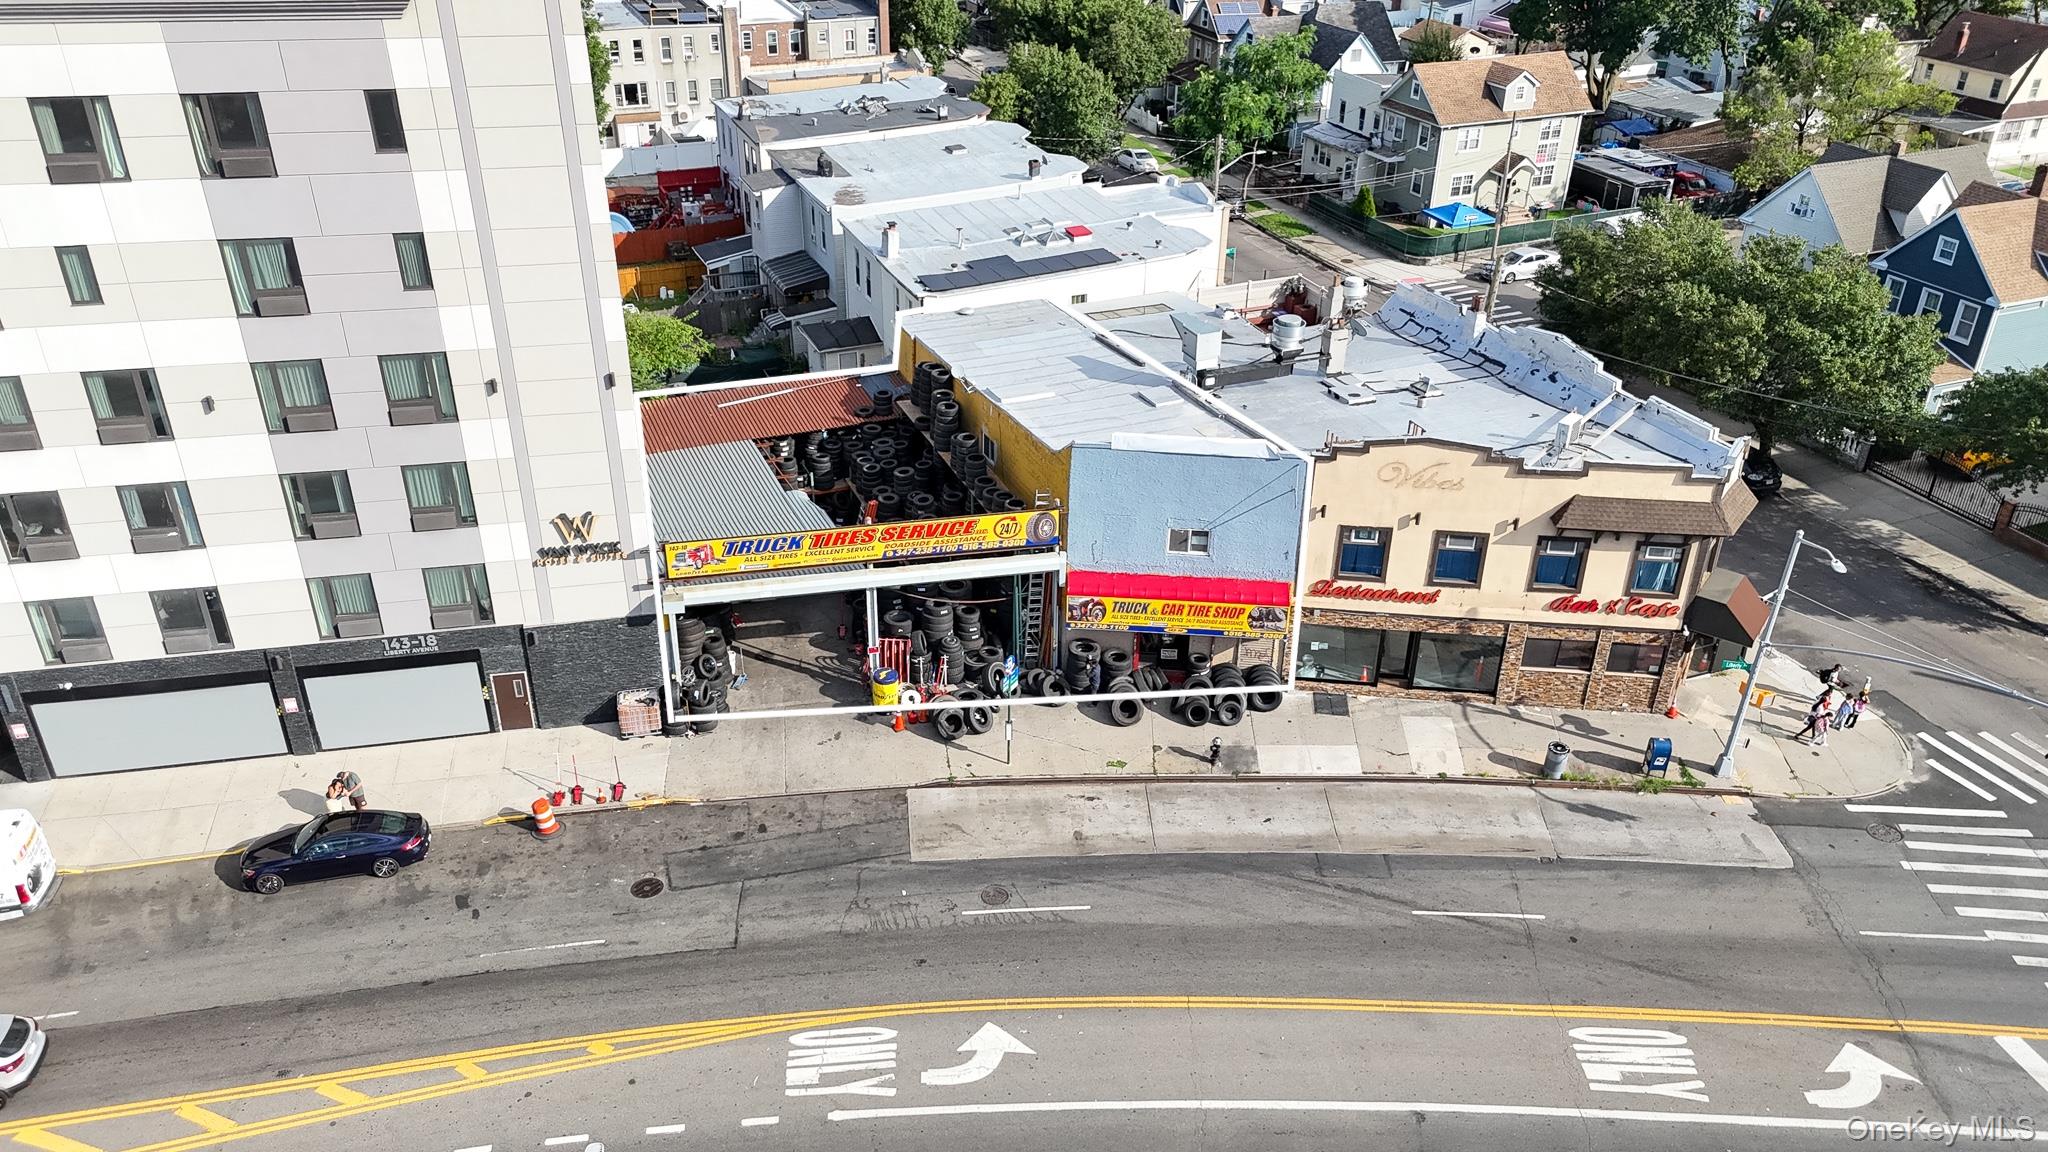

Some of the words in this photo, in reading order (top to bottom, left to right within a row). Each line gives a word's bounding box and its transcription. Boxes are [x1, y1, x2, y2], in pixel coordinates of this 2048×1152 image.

[1377, 462, 1464, 491] Vibes
[722, 533, 807, 557] TRUCK
[809, 527, 879, 549] TIRES
[879, 518, 979, 543] SERVICE
[1000, 522, 1018, 535] 24/7
[805, 548, 844, 557] EXCELLENT
[846, 545, 875, 554] SERVICE
[884, 540, 930, 549] ROADSIDE
[933, 535, 987, 545] ASSISTANCE
[1305, 578, 1441, 604] Restaurant
[1112, 601, 1151, 614] TRUCK
[1161, 602, 1184, 616] CAR
[1186, 604, 1212, 618] TIRE
[1213, 606, 1246, 619] SHOP
[1547, 594, 1599, 612] Bar
[1624, 596, 1680, 618] Cafe
[381, 634, 438, 650] 143-18
[411, 646, 439, 654] AVENUE
[785, 1026, 898, 1096] ONLY
[1568, 1027, 1710, 1103] ONLY
